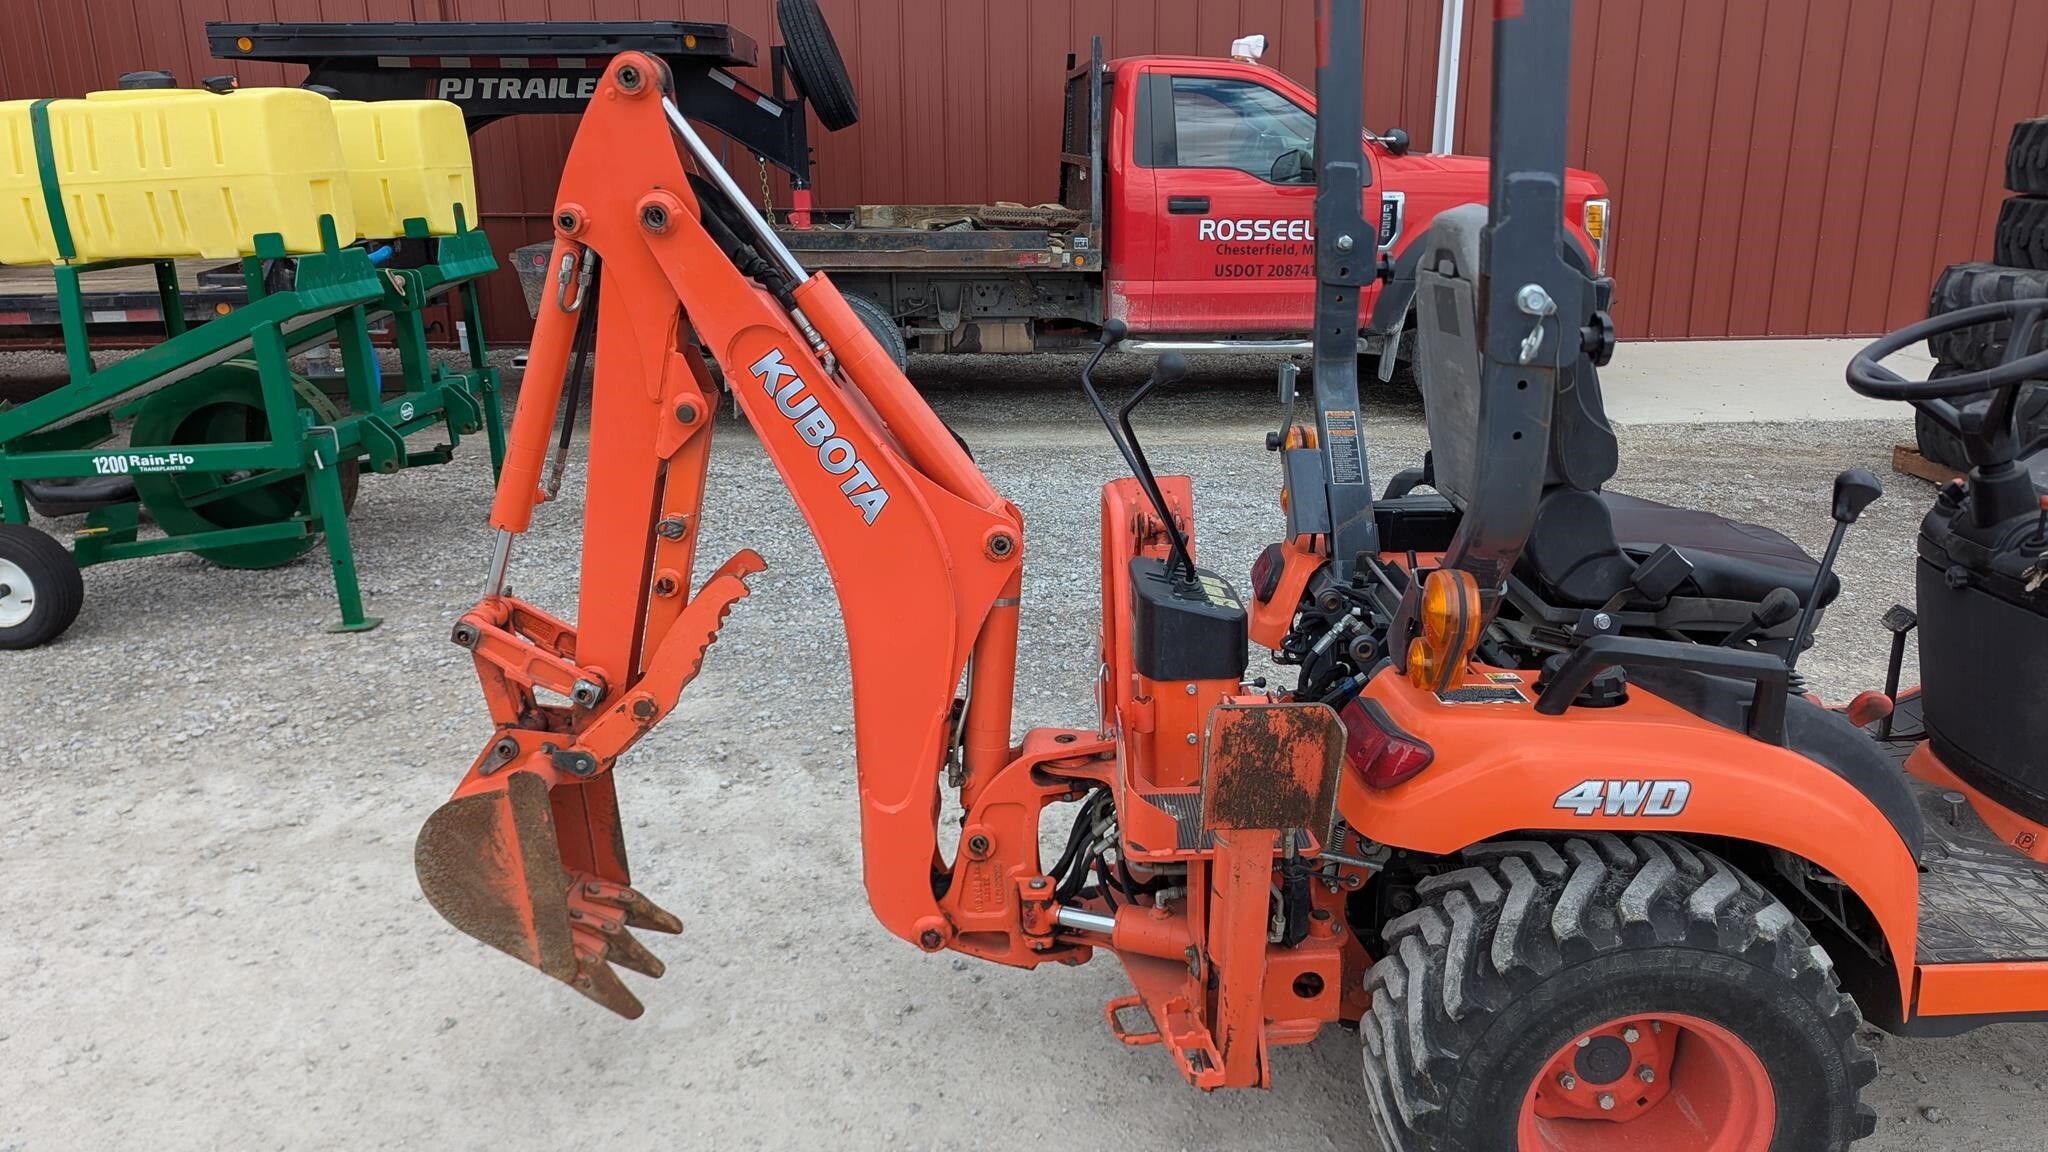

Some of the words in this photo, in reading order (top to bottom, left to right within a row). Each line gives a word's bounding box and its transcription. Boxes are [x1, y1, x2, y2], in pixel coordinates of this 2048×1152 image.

[438, 78, 474, 99] PJ
[478, 78, 601, 99] TRAILE
[1216, 243, 1298, 256] Chesterfield,
[1302, 243, 1314, 256] M
[1215, 264, 1264, 277] USDOT
[748, 346, 891, 527] KUBOTA
[92, 455, 128, 474] 1200
[128, 453, 194, 467] Rain-Flo
[1553, 779, 1692, 816] 4WD
